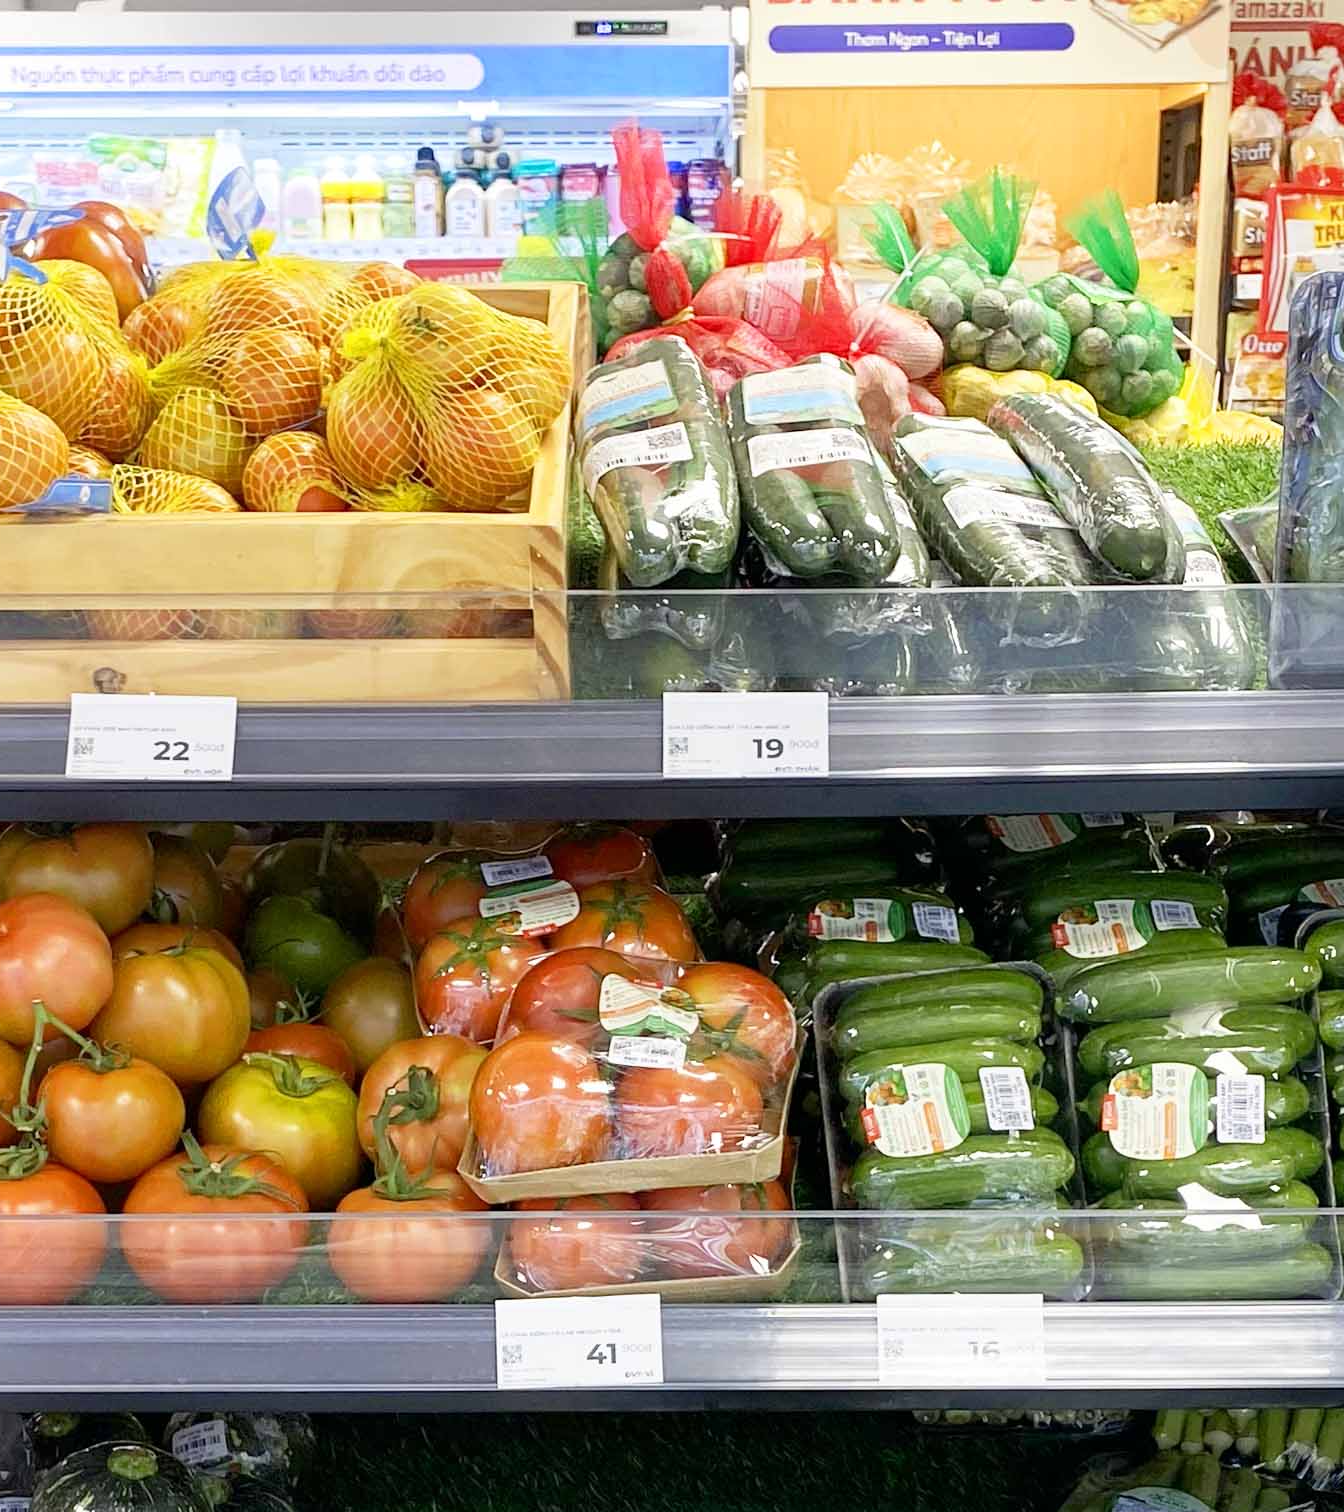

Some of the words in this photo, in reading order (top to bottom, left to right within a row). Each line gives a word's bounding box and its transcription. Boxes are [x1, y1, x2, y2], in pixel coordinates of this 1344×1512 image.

[1232, 0, 1324, 18] amazaki
[190, 70, 235, 87] cung
[154, 742, 189, 760] 22
[753, 739, 783, 758] 19
[587, 1344, 616, 1364] 41
